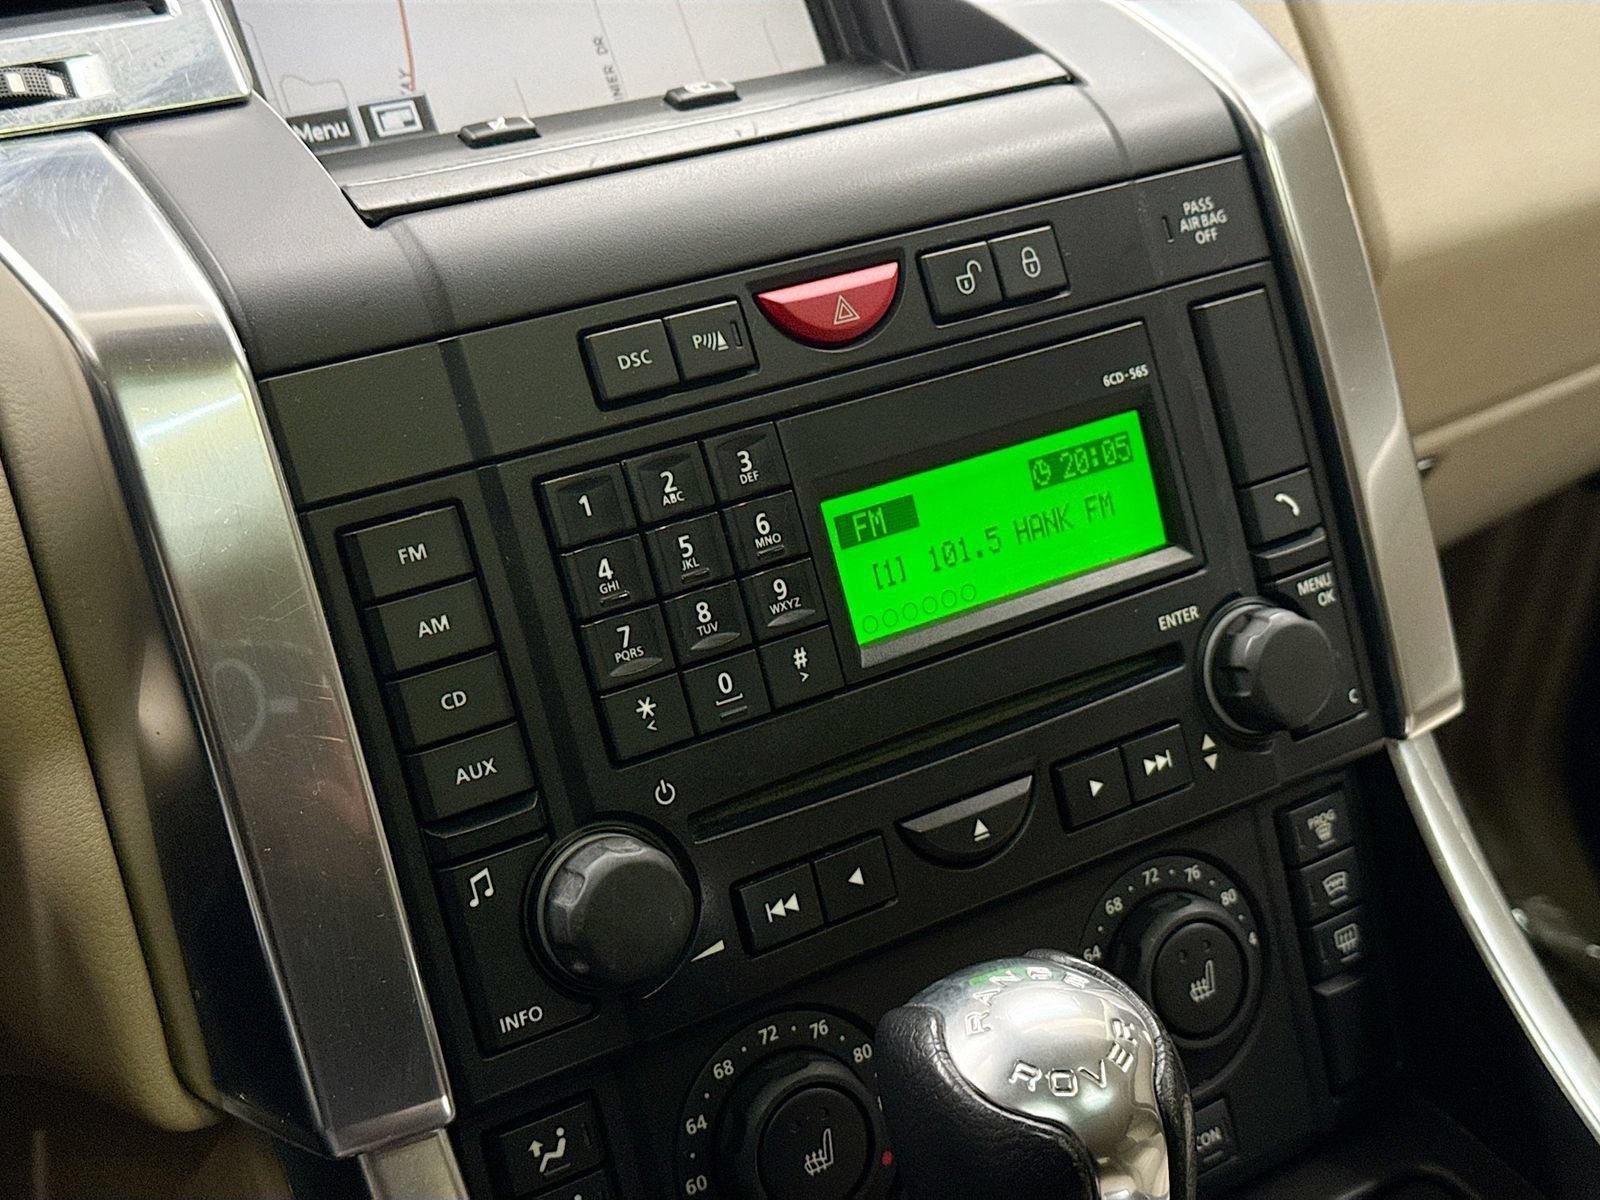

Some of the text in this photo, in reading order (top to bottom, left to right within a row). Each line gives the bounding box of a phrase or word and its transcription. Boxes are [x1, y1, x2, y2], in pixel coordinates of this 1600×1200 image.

[592, 36, 609, 56] DR
[293, 121, 351, 143] Menu
[1182, 196, 1215, 216] PASS
[1194, 226, 1219, 245] OFF
[616, 349, 653, 371] DSC
[1102, 364, 1149, 388] 6CD-565
[736, 450, 754, 473] 3
[1059, 435, 1132, 478] 20:05
[659, 470, 678, 494] 2
[739, 470, 760, 486] DEF
[578, 494, 593, 518] 1
[662, 490, 686, 507] ABC
[755, 512, 771, 536] 6
[852, 511, 887, 543] FM
[929, 526, 1002, 573] 101.5
[1013, 503, 1074, 545] HANK
[1085, 491, 1115, 523] FM
[677, 534, 694, 559] 5
[754, 532, 783, 550] MNO
[397, 543, 429, 566] FM
[681, 557, 701, 572] JKL
[597, 557, 614, 581] 4
[599, 579, 621, 595] GHI
[772, 577, 788, 601] 9
[1297, 572, 1333, 597] MENU
[769, 596, 802, 616] WXYZ
[1317, 589, 1336, 608] OK
[695, 601, 713, 624] 8
[1157, 605, 1201, 632] ENTER
[417, 613, 452, 639] AM
[615, 625, 632, 649] 7
[696, 620, 720, 638] TUV
[614, 645, 645, 664] PQRS
[717, 671, 734, 695] 0
[440, 690, 468, 711] CD
[455, 757, 498, 786] AUX
[1141, 866, 1161, 886] 72
[1183, 864, 1202, 883] 76
[1104, 896, 1123, 915] 68
[1220, 887, 1239, 907] 80
[1082, 944, 1101, 963] 64
[964, 965, 1091, 1037] RANGE
[499, 1004, 545, 1035] INFO
[808, 1018, 830, 1040] 76
[757, 1024, 780, 1045] 72
[852, 1042, 873, 1064] 80
[1008, 1017, 1138, 1097] ROVER
[712, 1058, 735, 1080] 68
[685, 1113, 708, 1136] 64
[685, 1173, 709, 1196] 60
